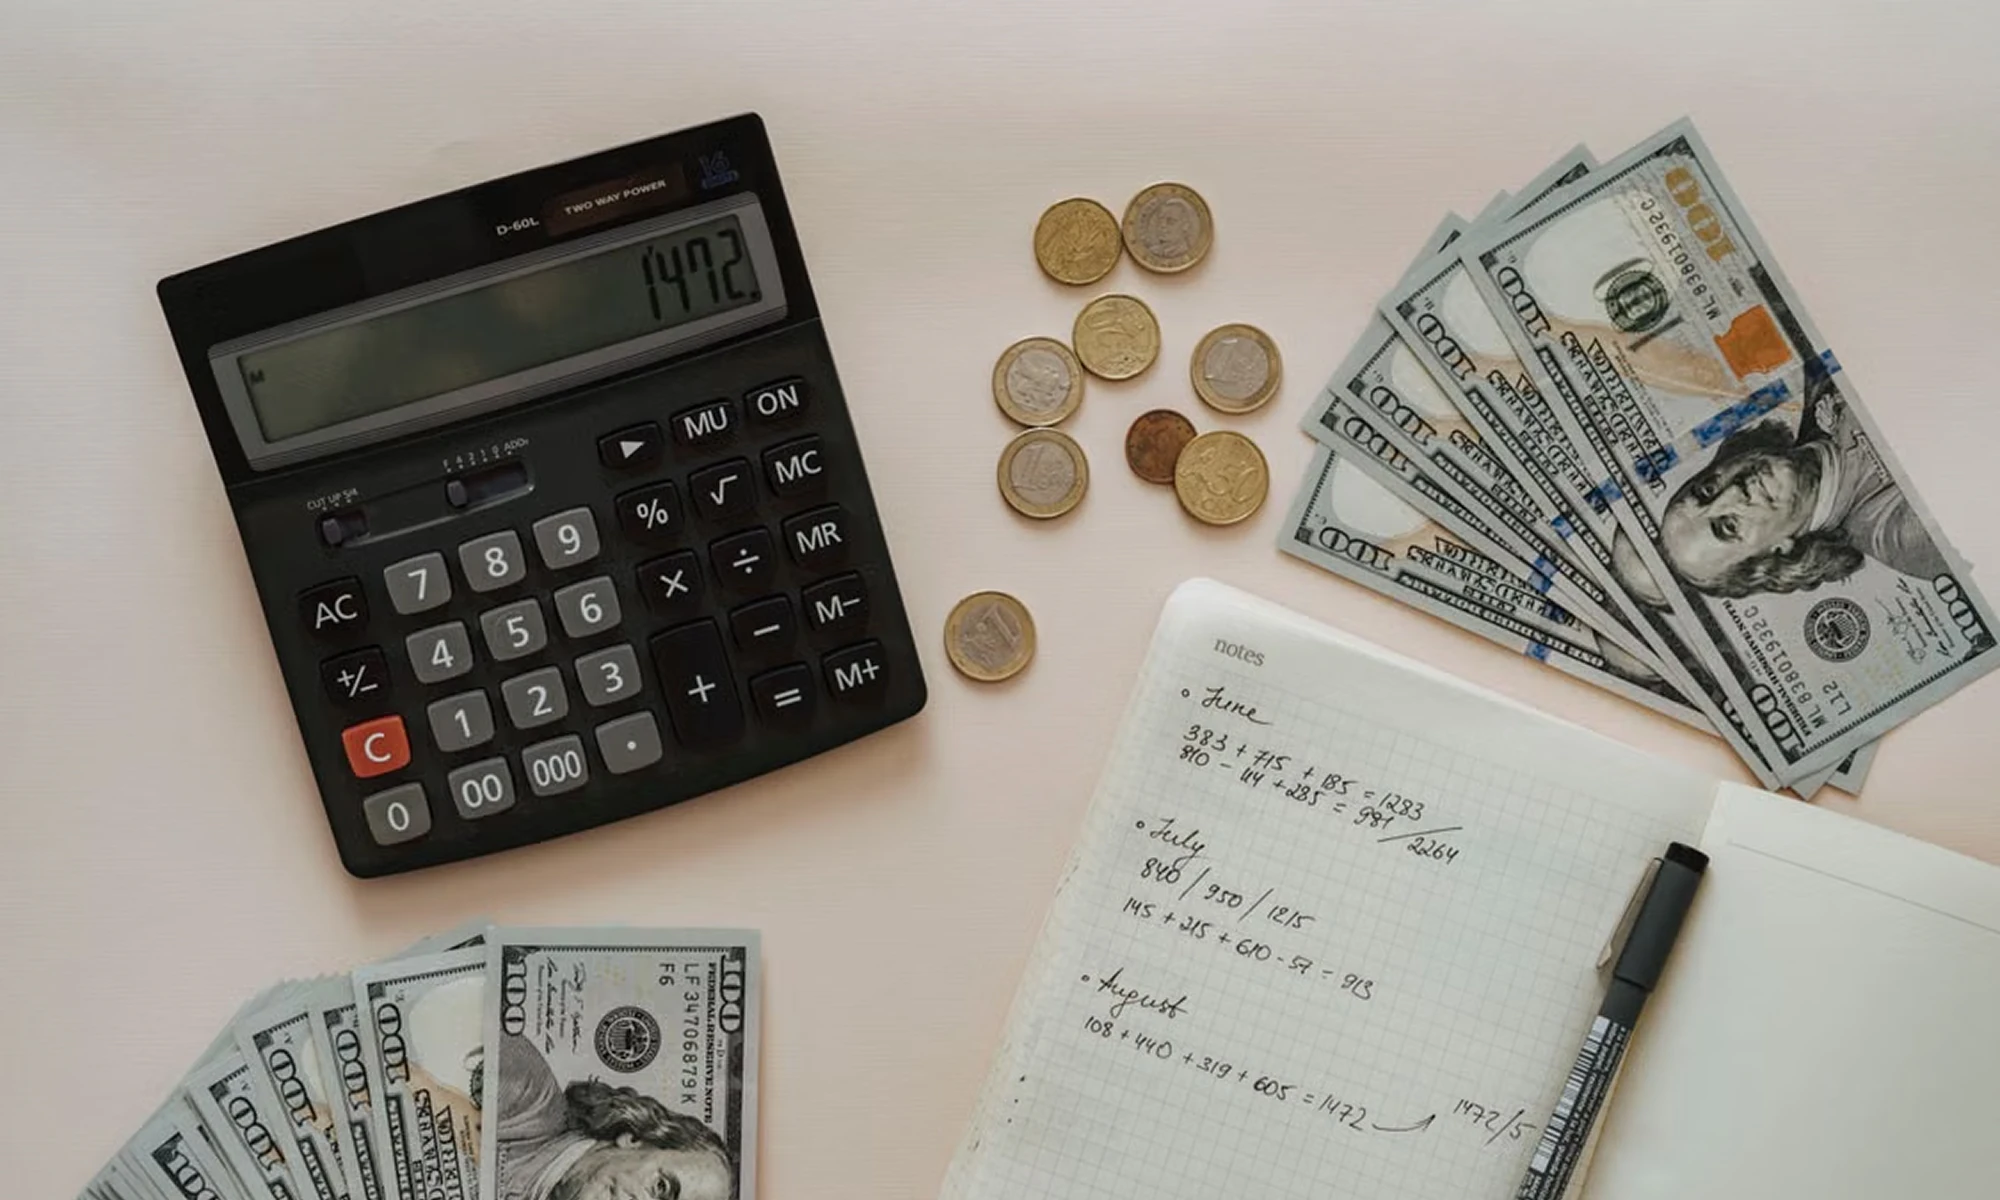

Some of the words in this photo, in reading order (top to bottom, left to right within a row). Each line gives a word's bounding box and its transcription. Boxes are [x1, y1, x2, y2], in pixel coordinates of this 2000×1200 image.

[564, 201, 593, 216] TWO
[595, 191, 621, 207] WAY
[623, 179, 667, 198] POWER
[1639, 196, 1656, 212] C
[1665, 166, 1737, 262] 100
[496, 216, 540, 237] D-60L
[1647, 209, 1708, 298] 83801932
[1499, 266, 1551, 338] 100
[1698, 294, 1723, 321] ML
[1417, 313, 1477, 381] 100
[1538, 347, 1590, 426] DOLLARS
[1557, 329, 1618, 416] STATES
[1582, 337, 1652, 438] AMERICA
[684, 407, 728, 439] MU
[757, 386, 799, 416] ON
[1370, 385, 1437, 446] 100
[1482, 367, 1556, 449] STATES
[1344, 415, 1407, 472] 100
[775, 451, 822, 484] MC
[637, 499, 669, 529] %
[558, 524, 581, 555] 9
[796, 522, 842, 554] MR
[1319, 525, 1395, 572] 100
[408, 569, 428, 600] 7
[484, 547, 509, 577] 8
[1404, 543, 1497, 594] STATES
[315, 594, 357, 629] AC
[579, 593, 602, 624] 6
[1398, 571, 1483, 616] DOLLARS
[1742, 604, 1759, 620] C
[1932, 572, 1987, 643] 100
[431, 639, 454, 669] 4
[507, 616, 529, 647] 5
[1213, 636, 1266, 668] notes
[600, 663, 624, 693] 3
[835, 658, 881, 691] M+
[1750, 617, 1813, 706] 83801932
[527, 685, 552, 716] 2
[1202, 686, 1273, 726] June
[1750, 683, 1806, 752] 100
[1774, 682, 1812, 737] FEDERAL
[1804, 704, 1828, 730] ML
[1822, 679, 1852, 717] L12
[454, 709, 471, 739] 1
[363, 733, 392, 763] C
[533, 751, 581, 787] 000
[462, 774, 502, 808] 00
[1183, 725, 1228, 752] 383
[1253, 751, 1293, 771] 715
[1321, 774, 1359, 796] 185
[1379, 793, 1425, 822] 1283
[387, 802, 409, 832] 0
[1240, 767, 1265, 787] 114
[1354, 806, 1395, 831] 981
[1150, 818, 1205, 871] July
[1407, 836, 1460, 864] 2264
[1140, 857, 1182, 885] 840
[1204, 882, 1243, 910] 950
[1267, 904, 1316, 929] 1215
[1123, 897, 1157, 919] 145
[1236, 939, 1272, 961] 610
[1341, 973, 1374, 1000] 913
[659, 962, 675, 987] F6
[683, 963, 699, 985] LF
[706, 962, 717, 1022] FEDERAL
[718, 955, 744, 1034] 100
[1098, 967, 1188, 1019] August
[503, 960, 527, 1037] 100
[377, 1003, 410, 1085] 100
[680, 991, 700, 1088] 34706879
[704, 1024, 715, 1086] RESERVE
[269, 1049, 317, 1128] 100
[335, 1029, 372, 1111] 100
[1084, 1016, 1114, 1038] 108
[1135, 1033, 1172, 1059] 440
[1197, 1057, 1232, 1079] 319
[1254, 1076, 1297, 1101] 605
[1318, 1094, 1367, 1131] 1472
[680, 1093, 696, 1104] K
[703, 1088, 713, 1123] NOTE
[1453, 1098, 1538, 1146] 1472/5
[229, 1096, 286, 1172] 100
[384, 1098, 412, 1189] DOLLARS
[408, 1088, 445, 1187] STATES
[352, 1123, 380, 1200] OLLARS
